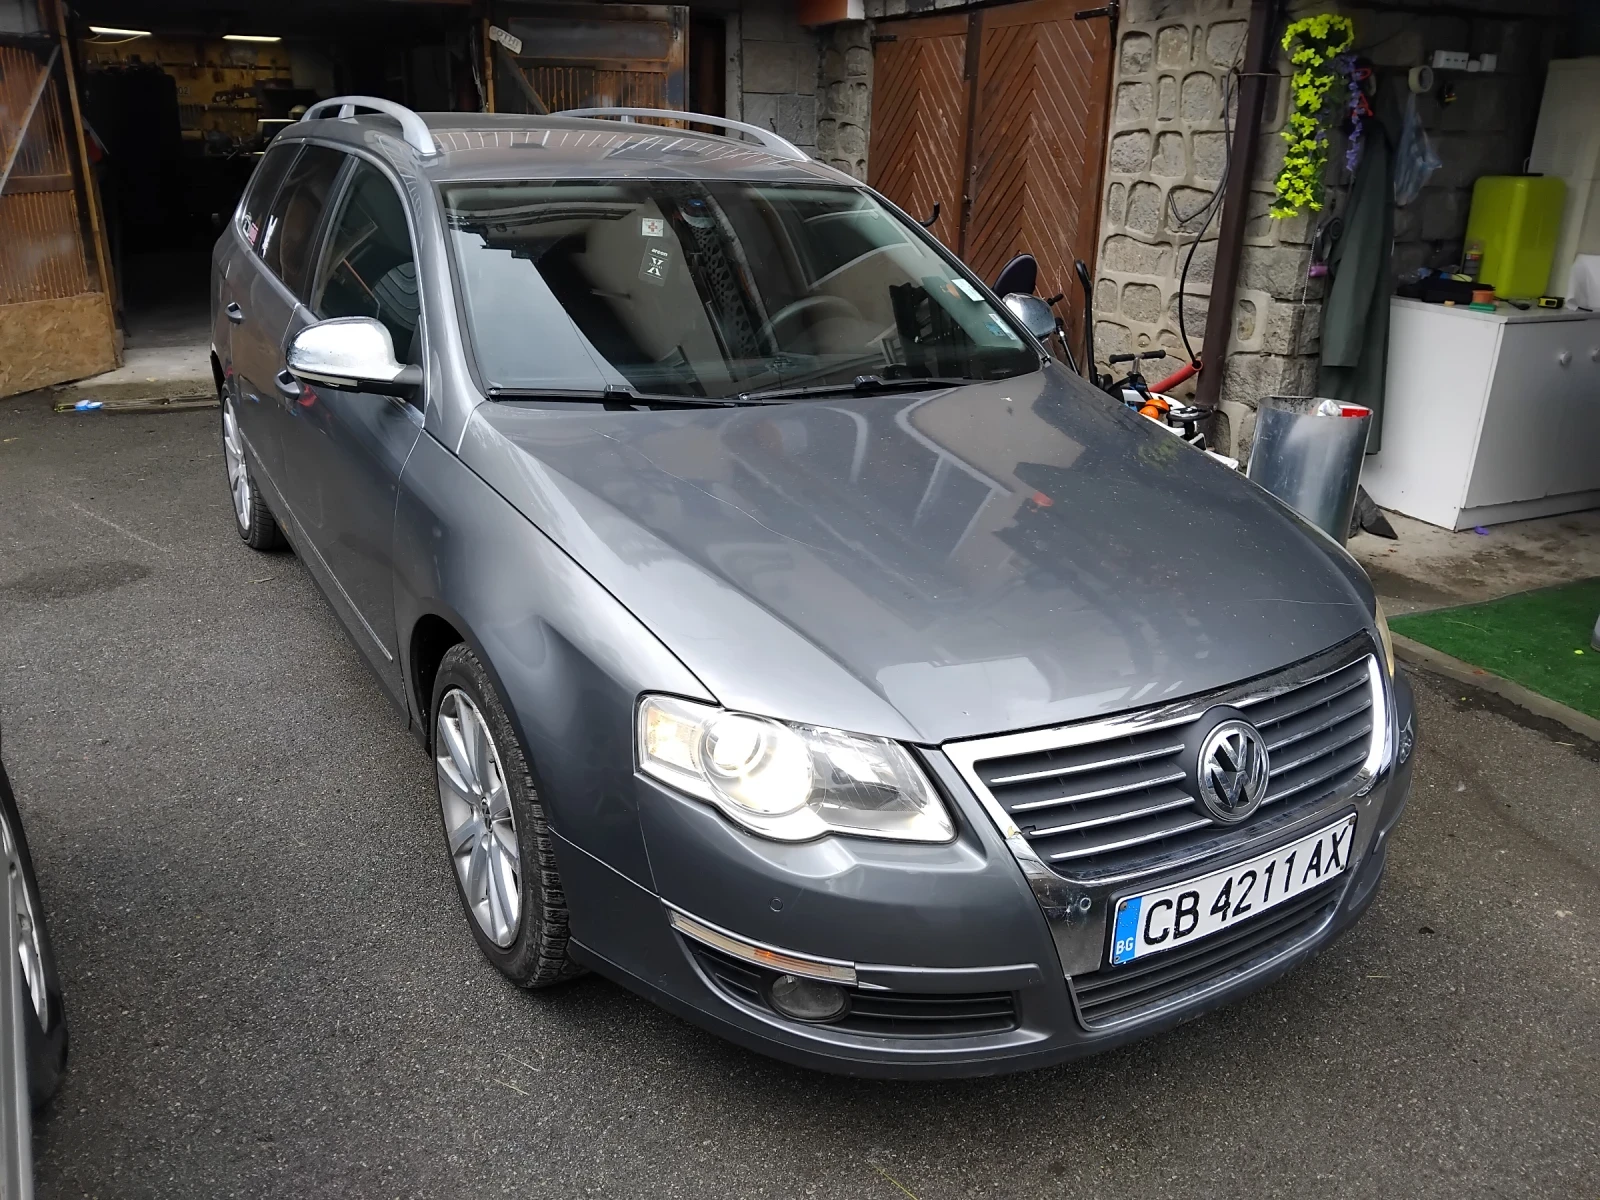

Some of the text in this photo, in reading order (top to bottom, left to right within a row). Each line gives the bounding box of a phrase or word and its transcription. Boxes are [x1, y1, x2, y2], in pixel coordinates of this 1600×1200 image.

[1143, 825, 1350, 946] CB 4211 AX
[1116, 937, 1134, 956] BG
